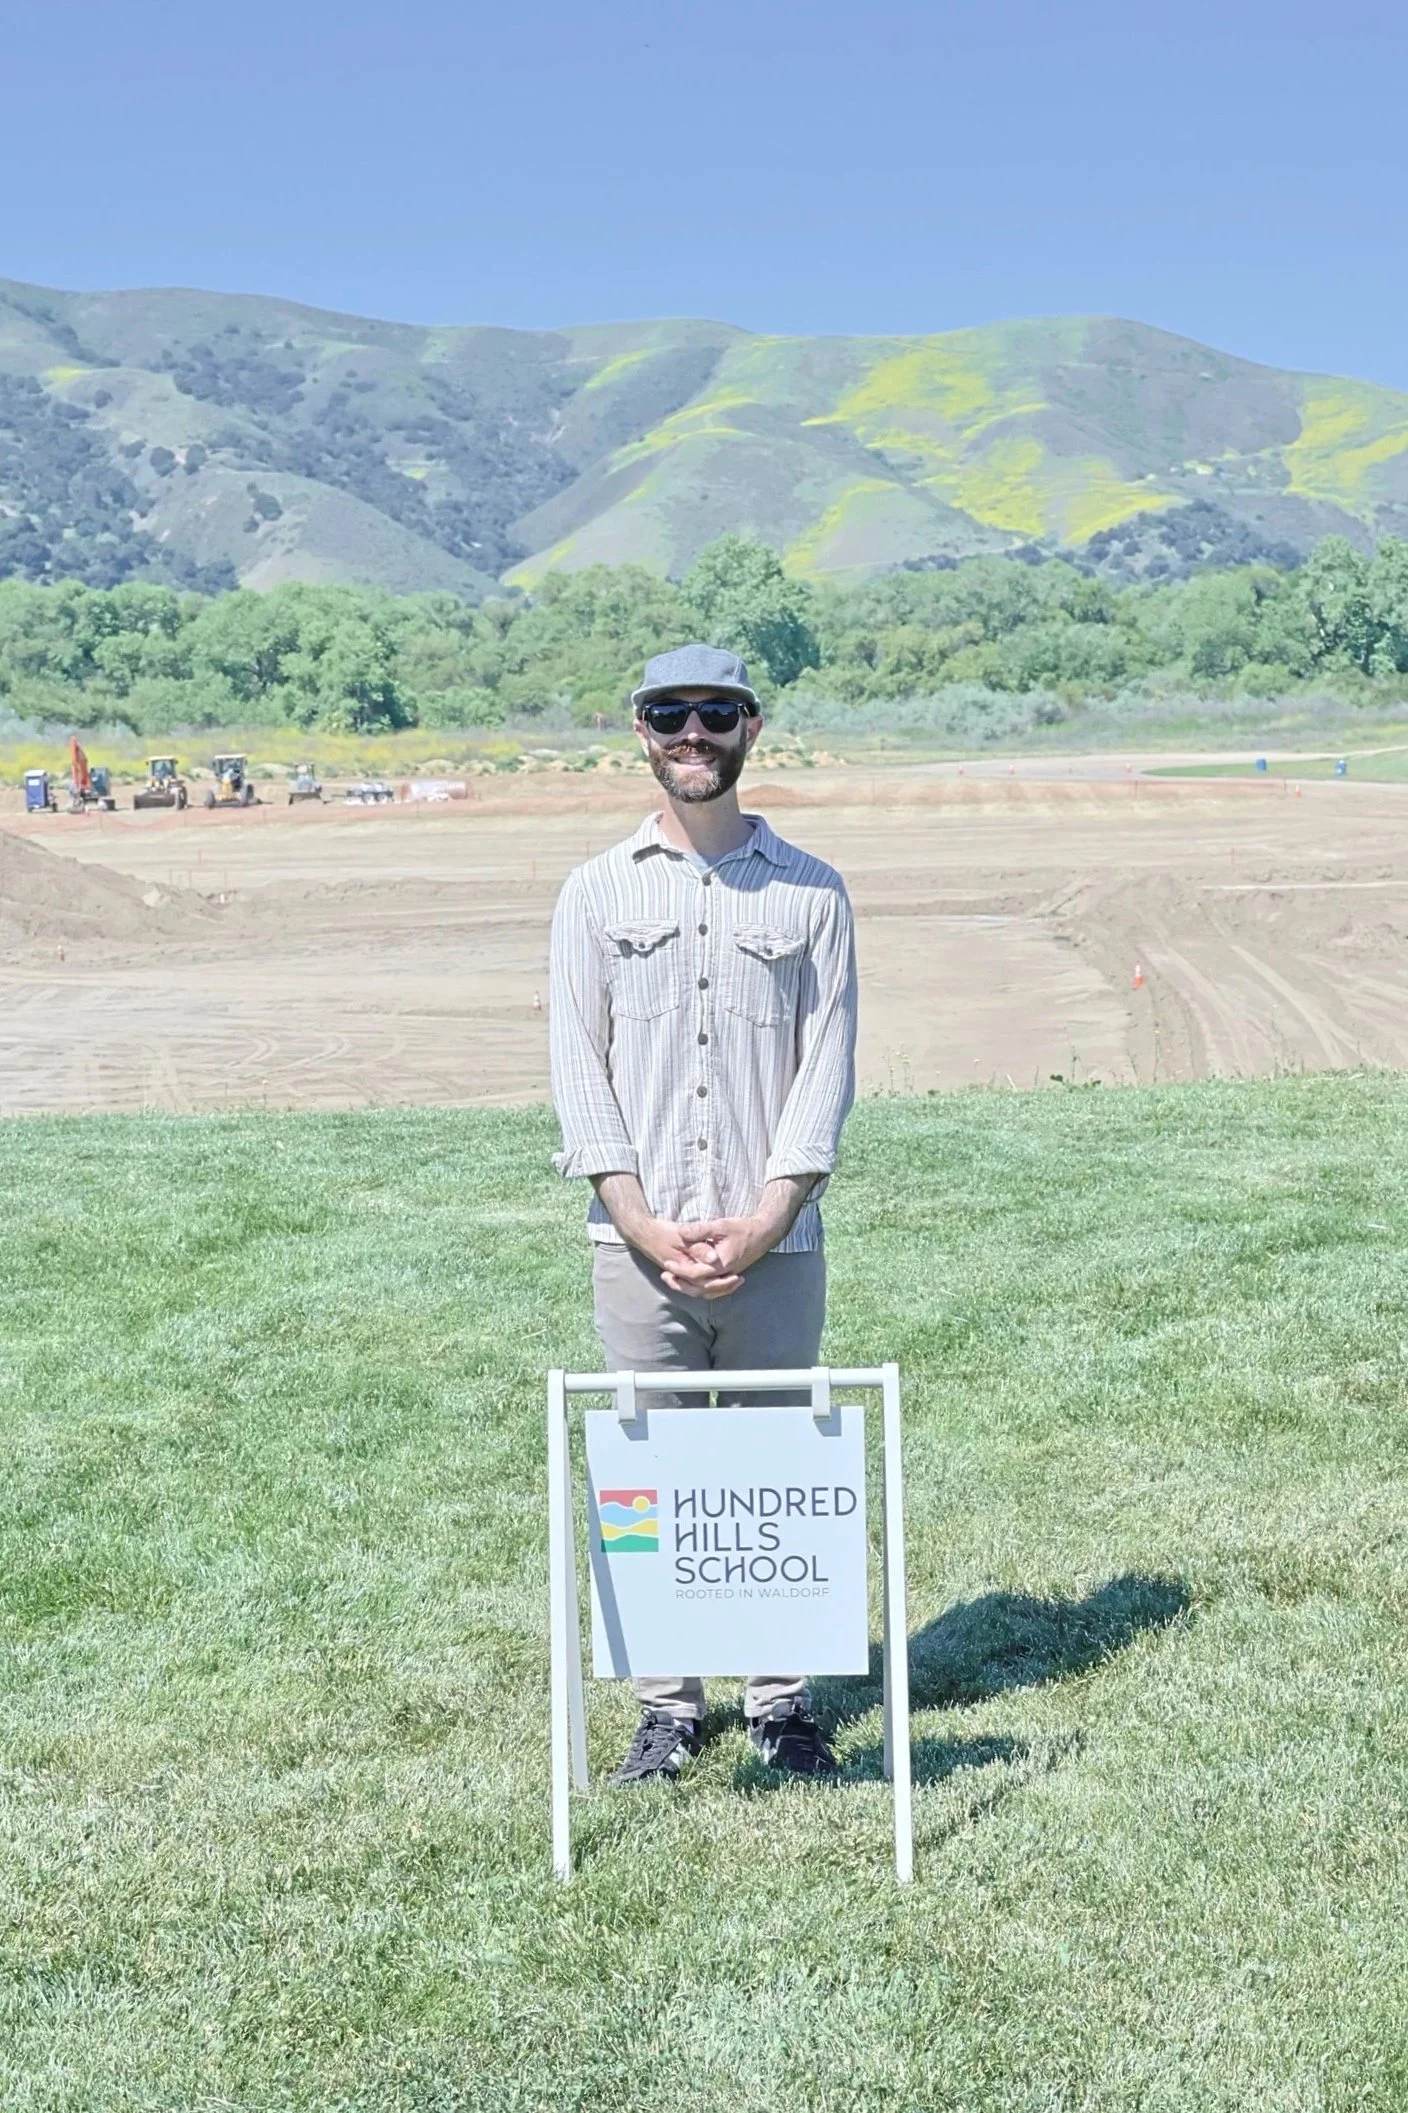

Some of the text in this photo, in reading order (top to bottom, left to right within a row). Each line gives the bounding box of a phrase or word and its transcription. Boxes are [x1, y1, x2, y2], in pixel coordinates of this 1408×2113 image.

[674, 1487, 857, 1518] HUNDRED
[675, 1522, 780, 1552] HILLS
[675, 1555, 829, 1584] SCHOOL
[676, 1587, 829, 1599] ROOTED IN WALDORF
